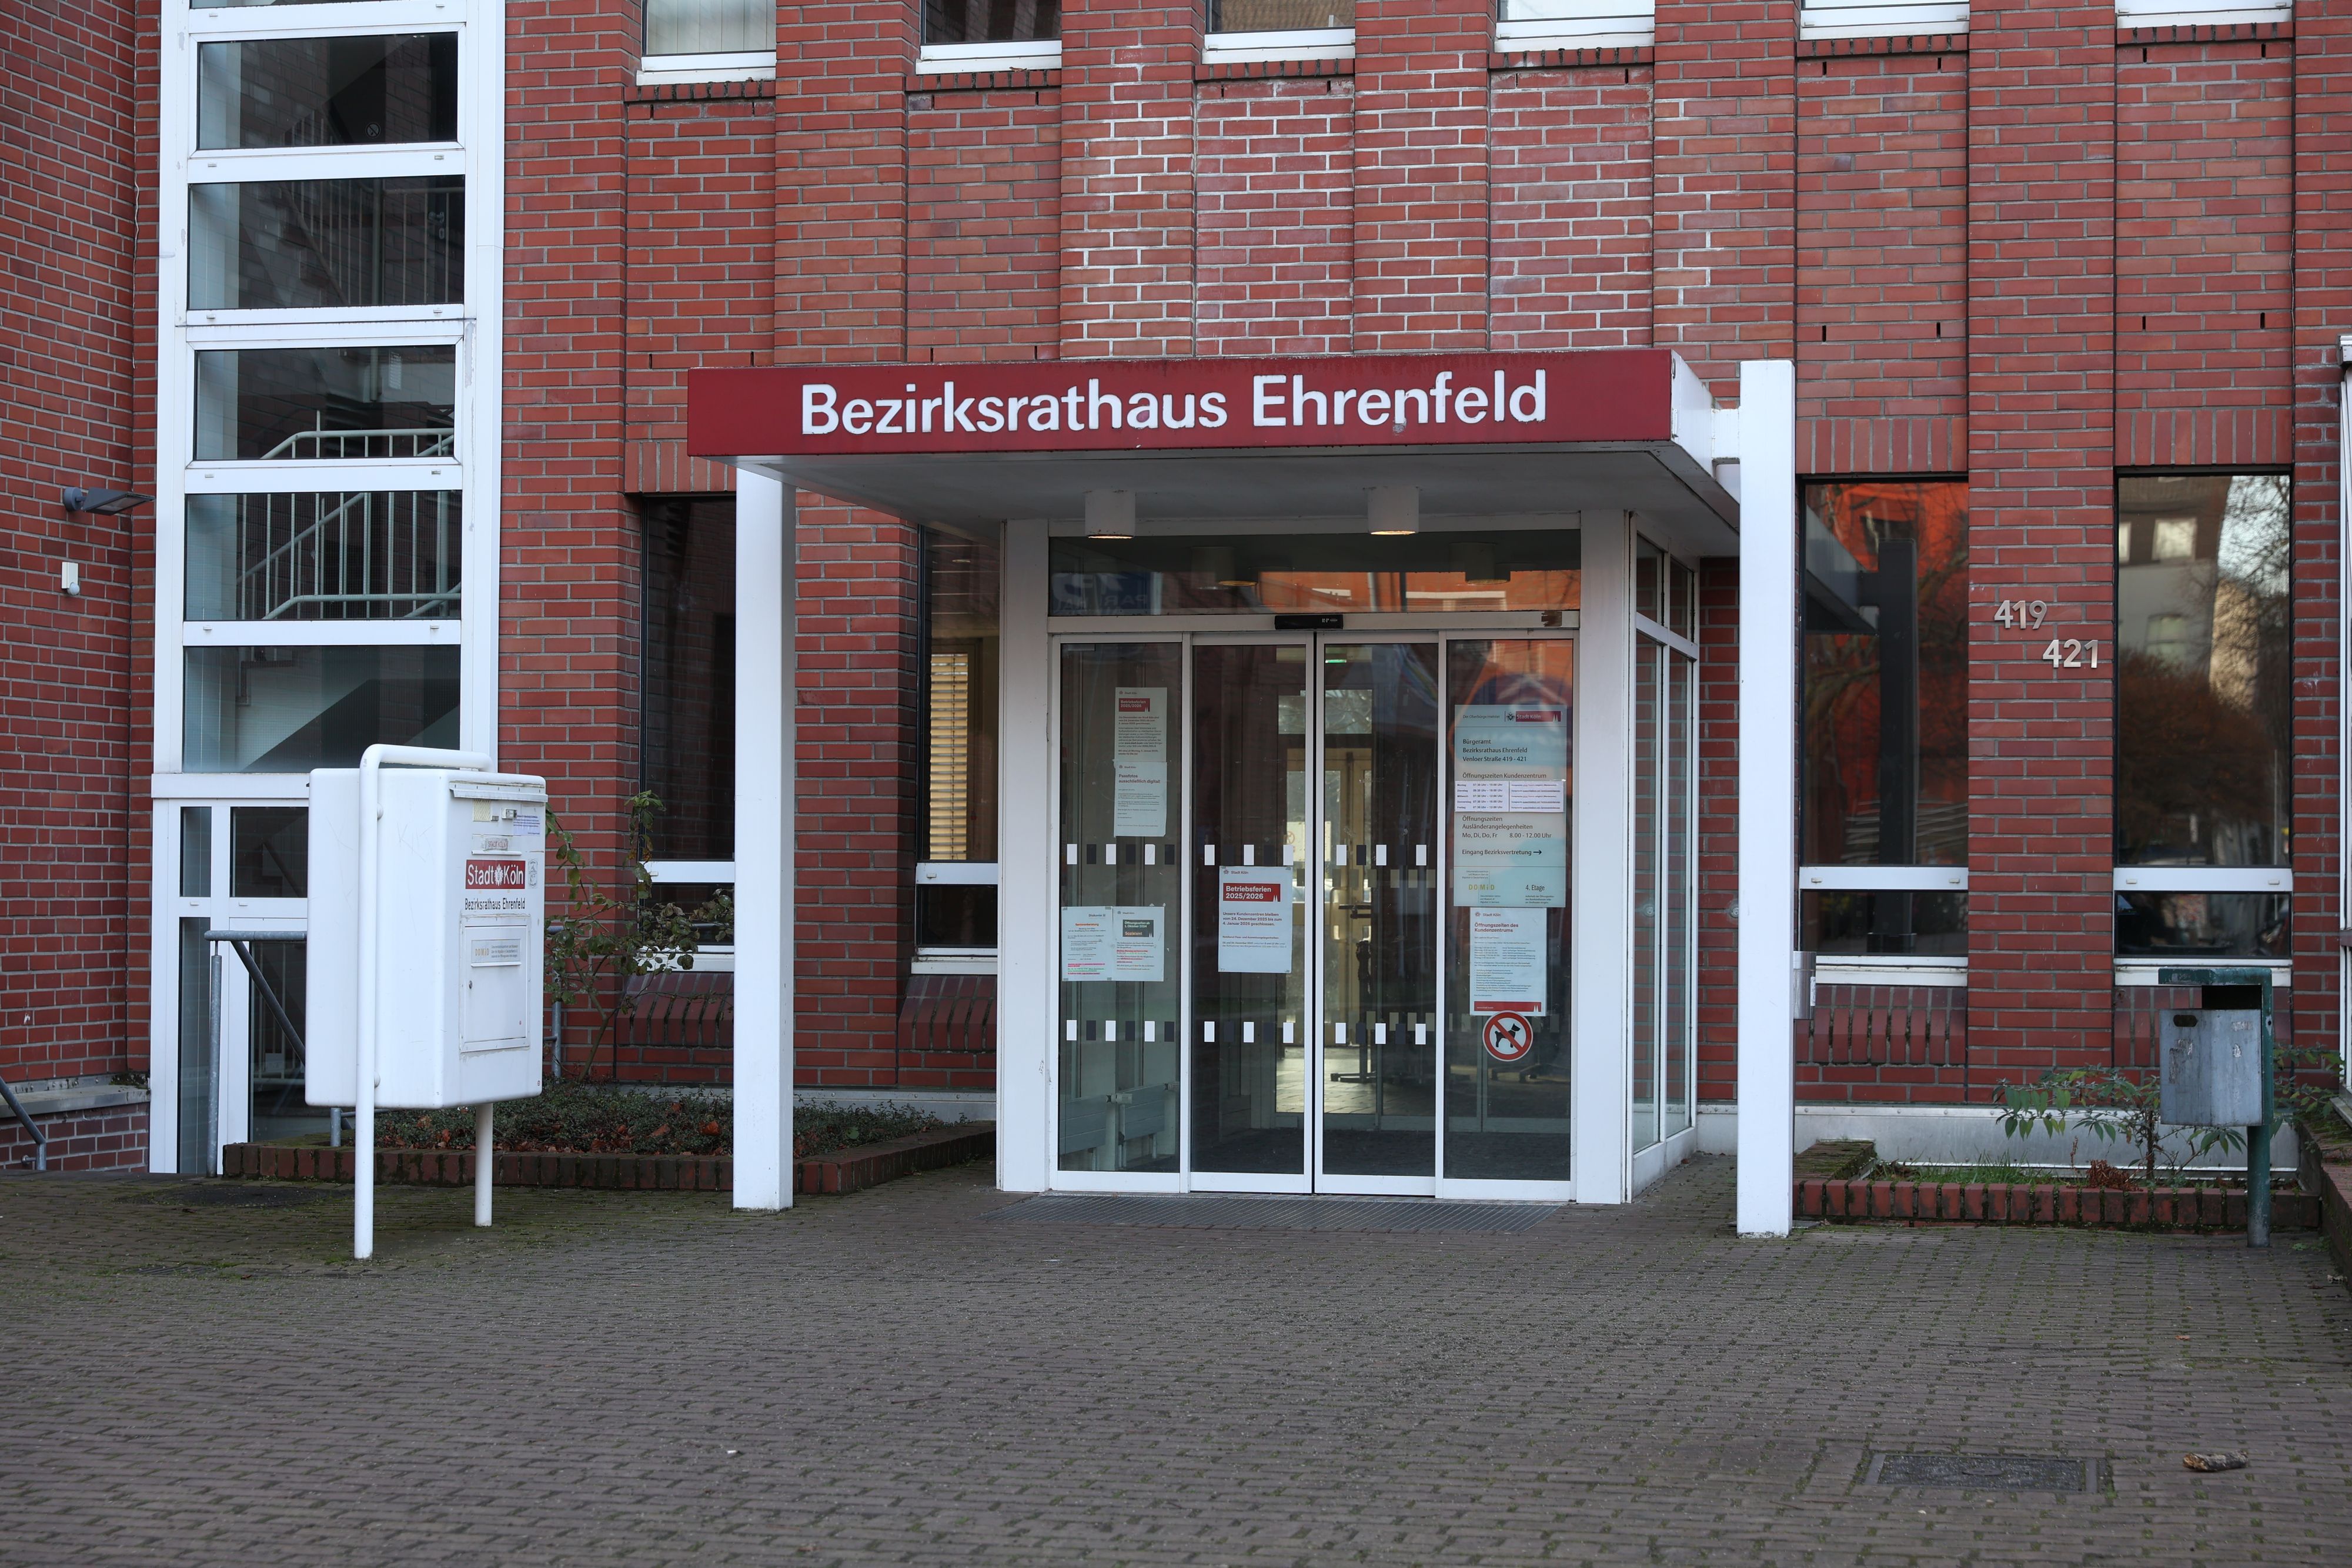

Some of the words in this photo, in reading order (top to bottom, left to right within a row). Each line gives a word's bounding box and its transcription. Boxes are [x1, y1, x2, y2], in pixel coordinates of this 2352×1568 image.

[803, 378, 1227, 435] Bezirksrathaus
[1253, 370, 1547, 428] Ehrenfeld
[1994, 600, 2047, 629] 419
[2043, 639, 2098, 668] 421
[468, 864, 494, 885] Stadt
[504, 864, 523, 885] Köln
[465, 898, 501, 910] Bezirksrathaus
[503, 898, 525, 910] Ehrenfeld
